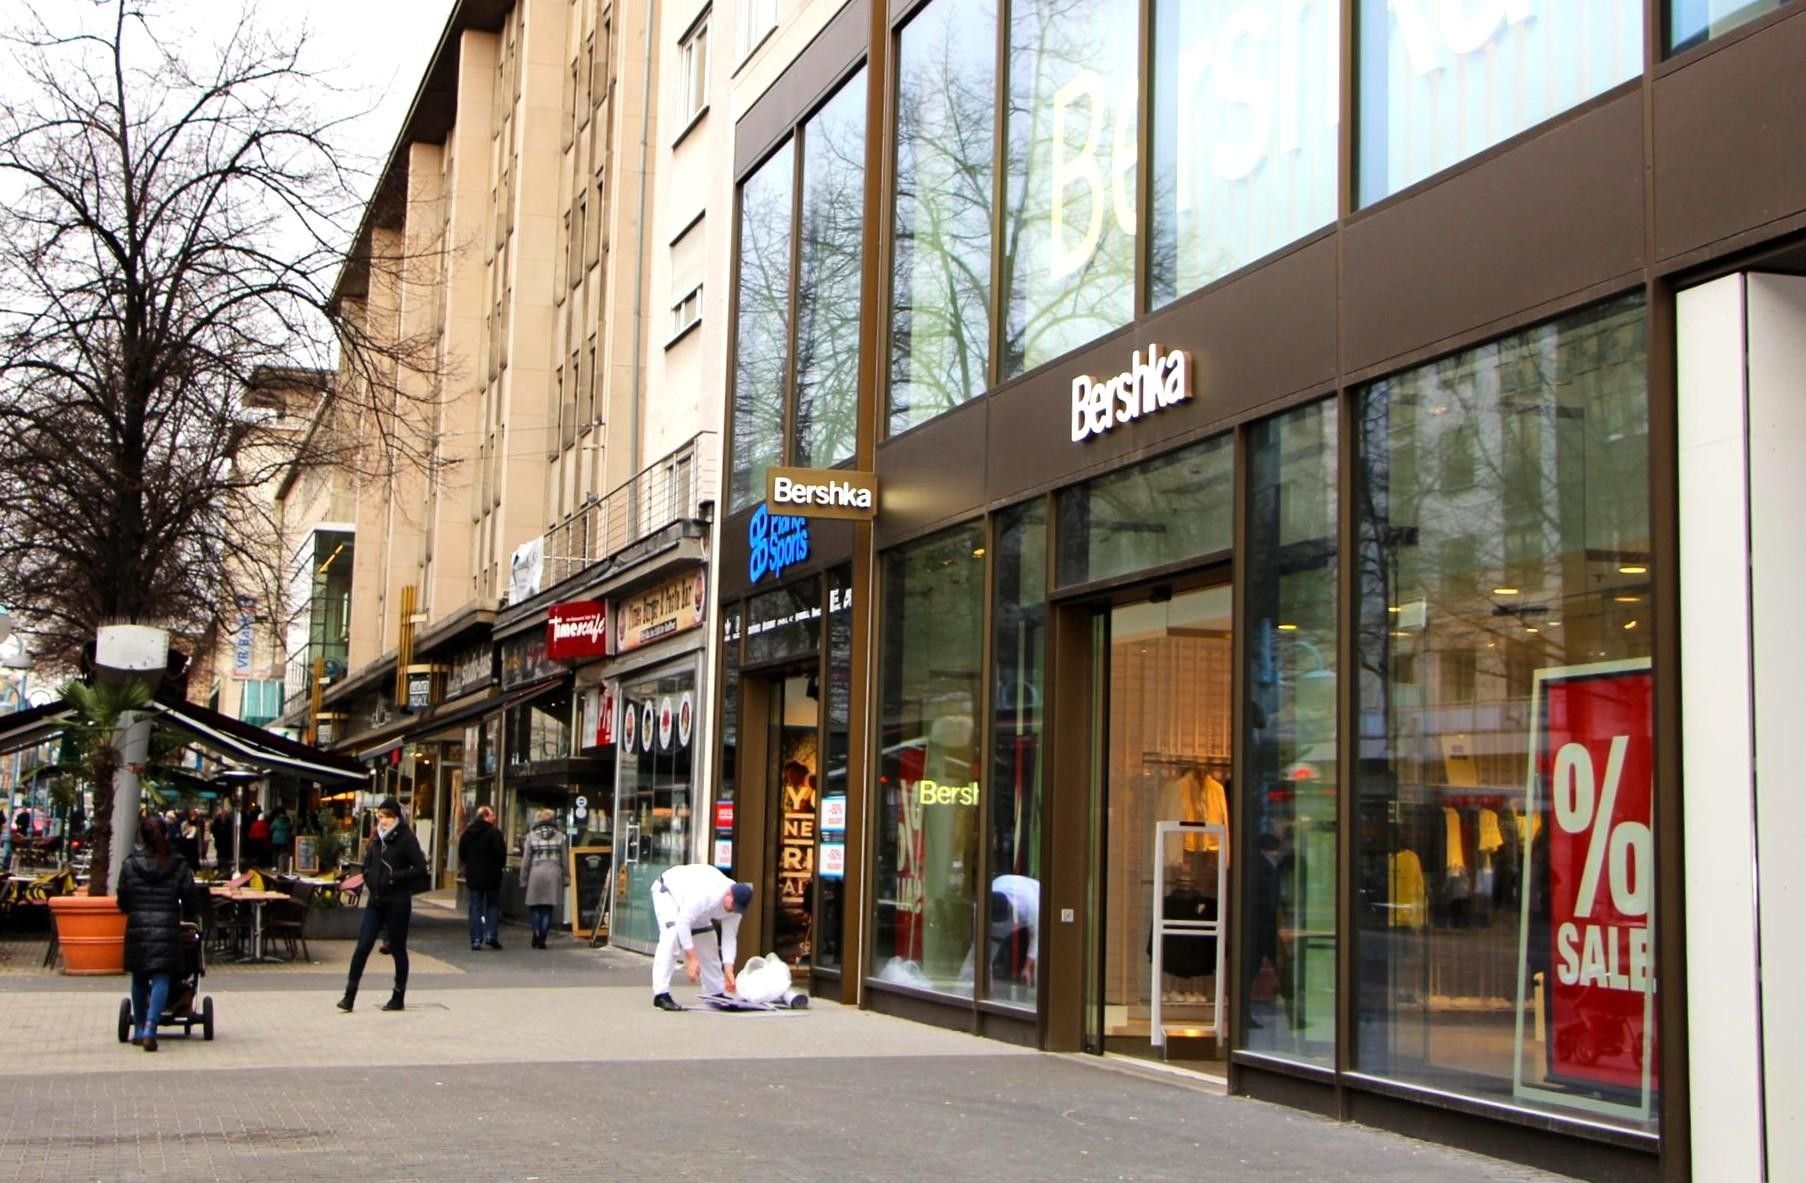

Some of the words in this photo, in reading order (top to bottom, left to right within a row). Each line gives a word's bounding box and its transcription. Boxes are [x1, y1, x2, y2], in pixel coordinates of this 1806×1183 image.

[1071, 343, 1187, 442] Bershka
[774, 476, 872, 508] Bershka
[769, 529, 807, 578] Sports
[1557, 922, 1657, 993] SALE
